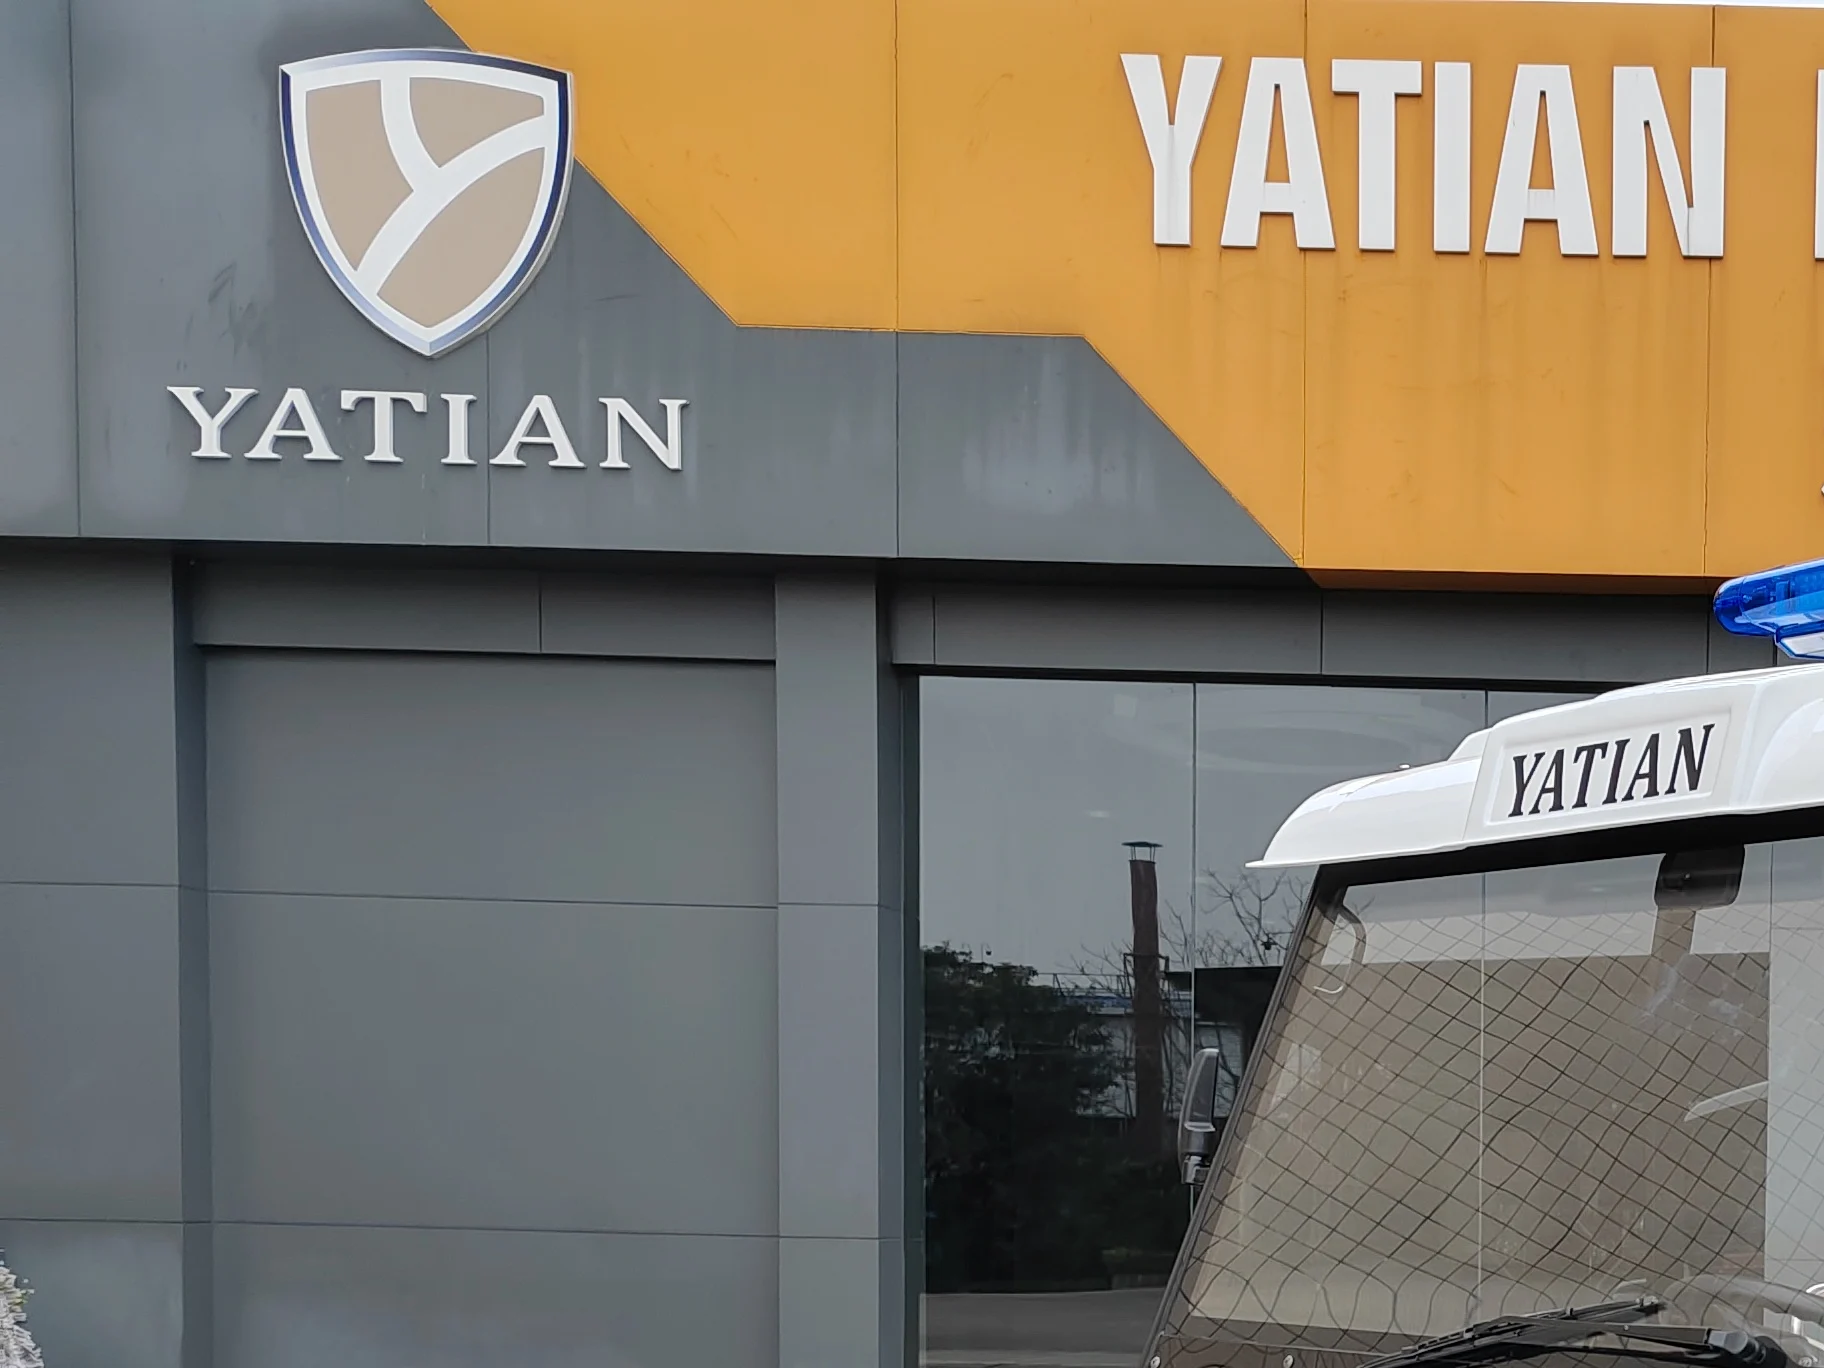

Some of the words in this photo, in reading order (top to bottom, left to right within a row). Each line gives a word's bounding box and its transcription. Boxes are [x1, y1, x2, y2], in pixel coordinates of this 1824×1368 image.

[1120, 53, 1726, 258] YATIAN
[166, 385, 689, 471] YATIAN
[1509, 723, 1714, 817] YATIAN
